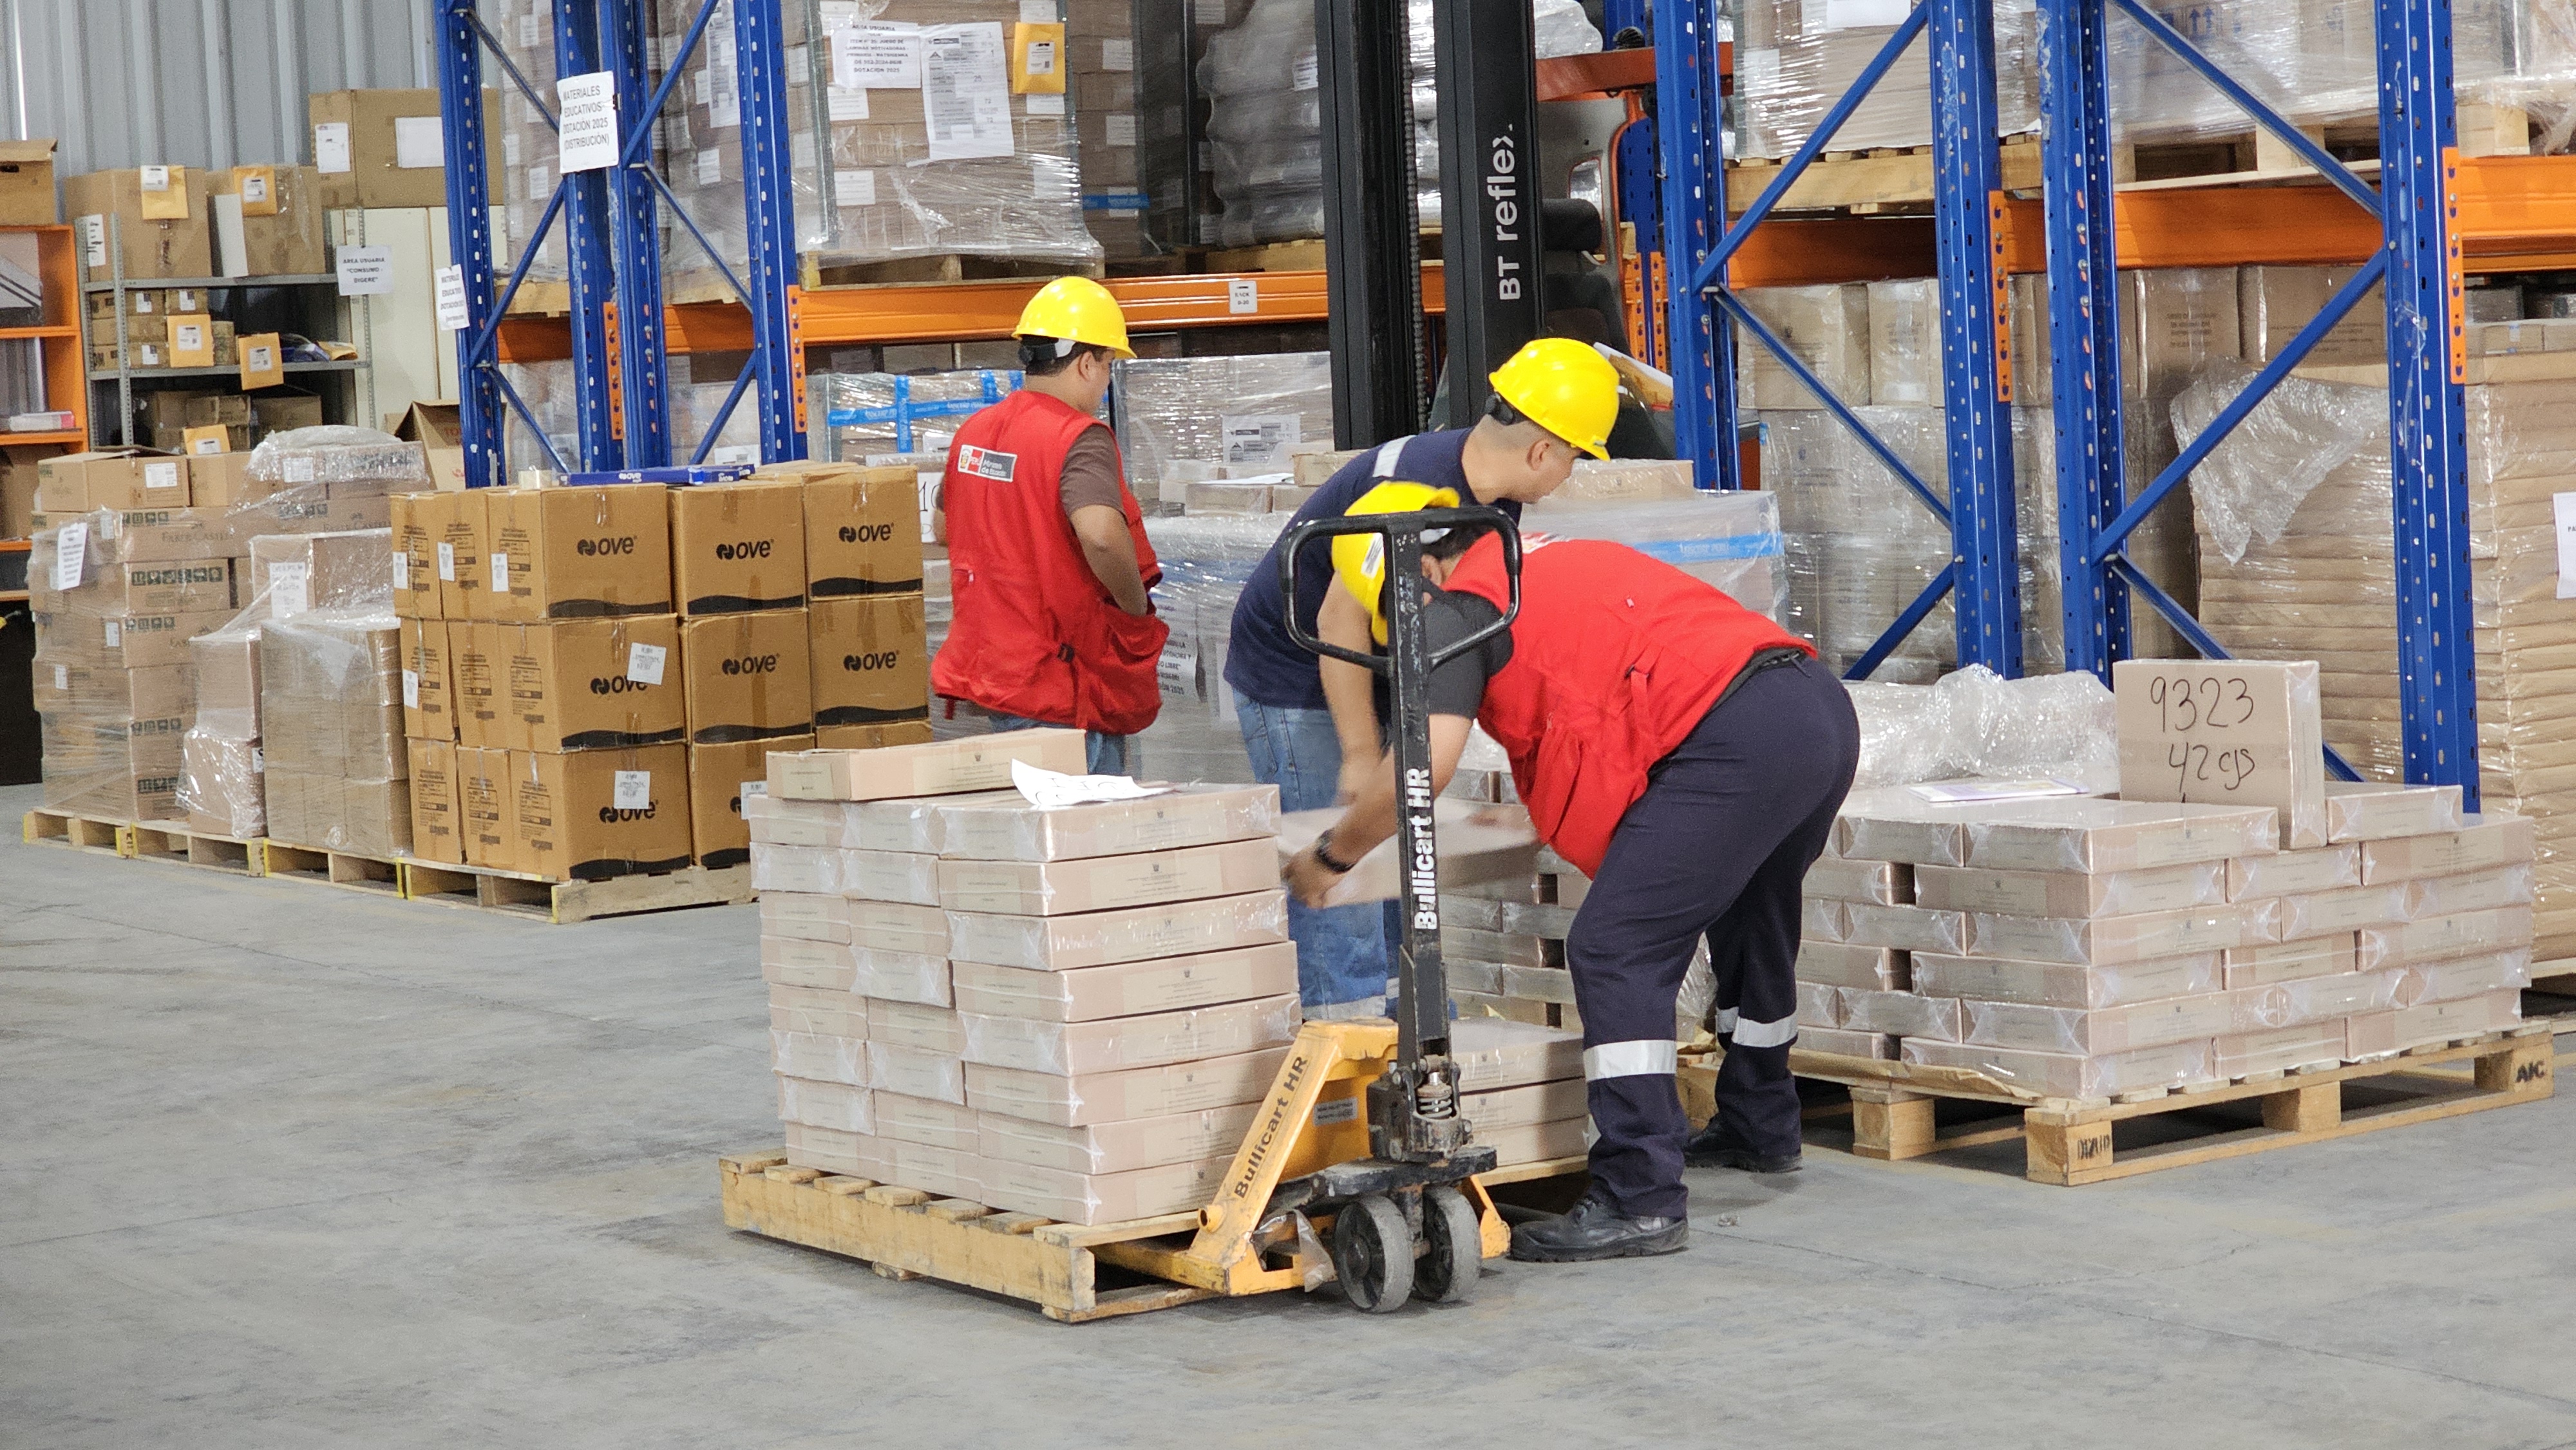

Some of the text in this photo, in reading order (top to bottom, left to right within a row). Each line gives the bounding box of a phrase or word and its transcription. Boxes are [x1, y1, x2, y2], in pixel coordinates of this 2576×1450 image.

[563, 85, 601, 102] MATERIALES
[592, 117, 609, 129] 2025
[1498, 256, 1520, 300] BT
[2150, 676, 2254, 733] 9323
[2168, 742, 2209, 793] 42
[1406, 768, 1438, 930] Bullicart HR
[1234, 1056, 1308, 1198] Bullicart HR
